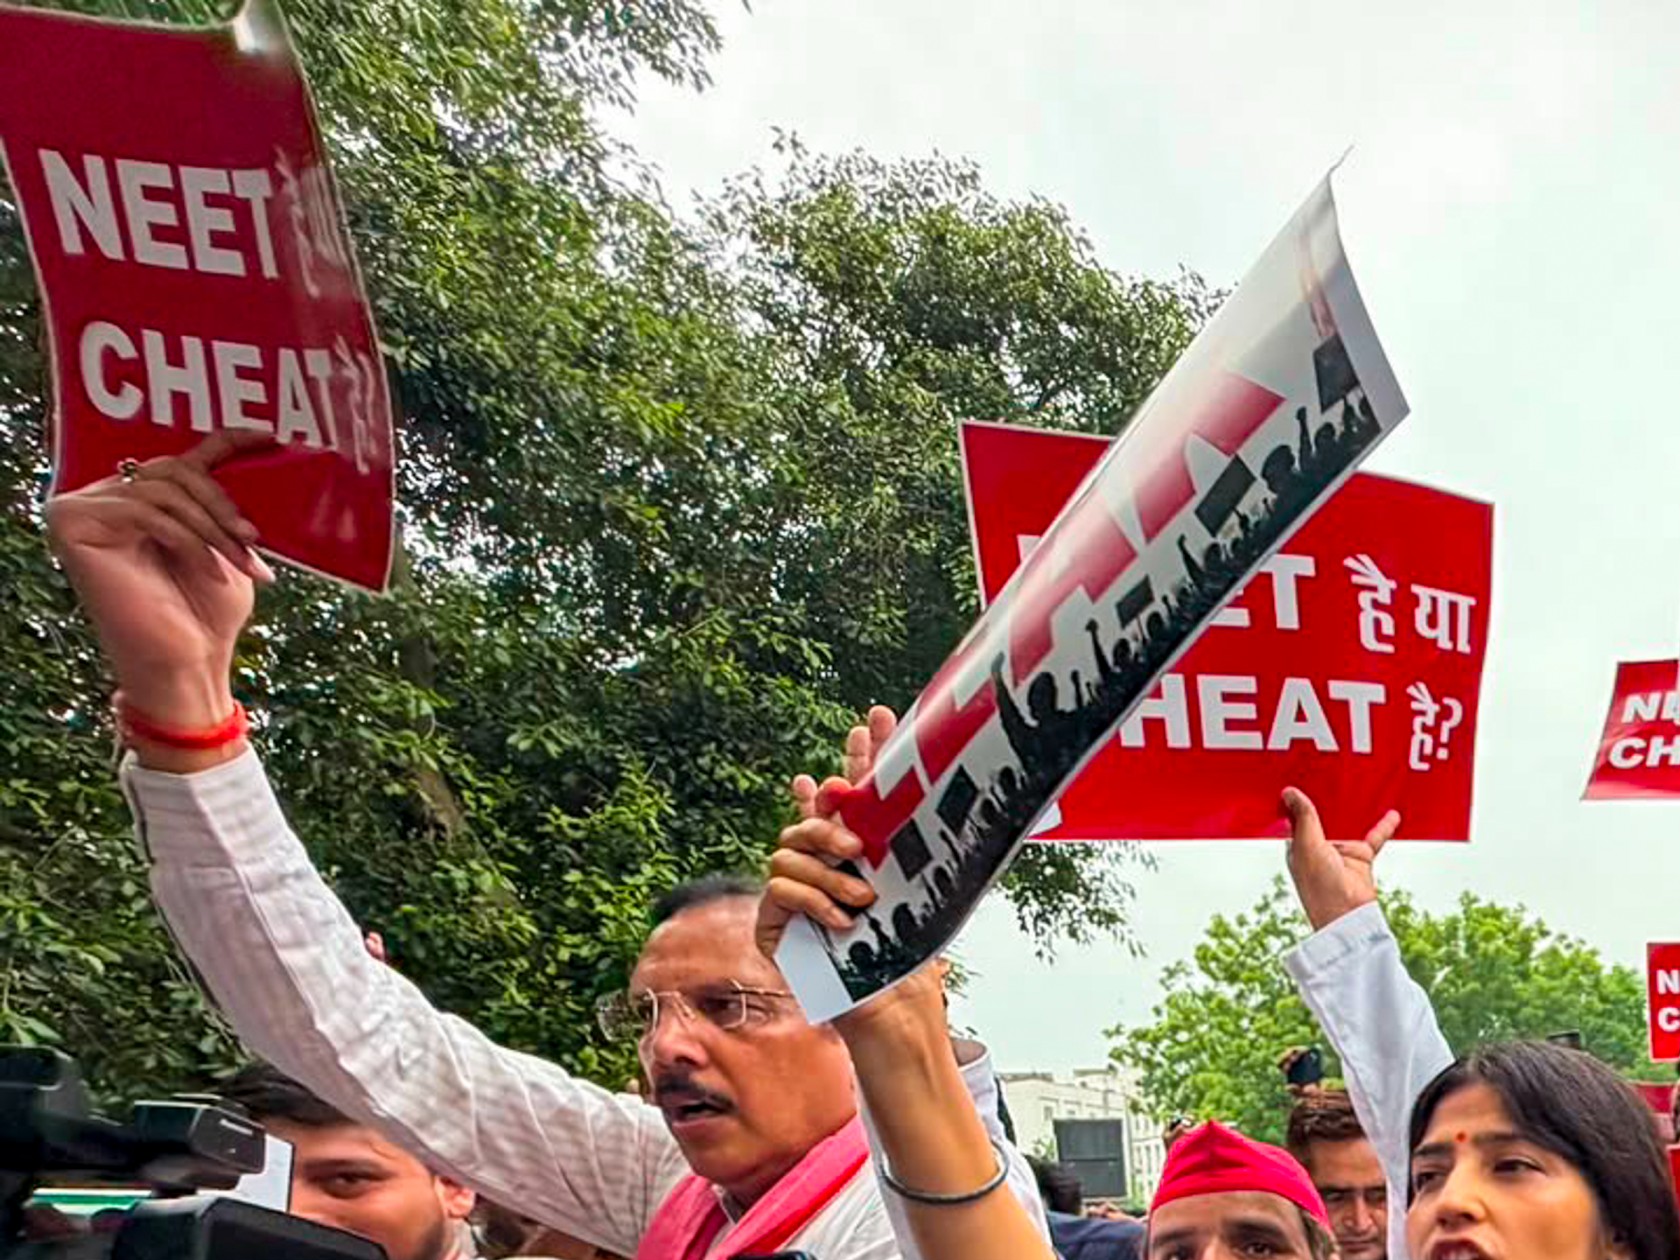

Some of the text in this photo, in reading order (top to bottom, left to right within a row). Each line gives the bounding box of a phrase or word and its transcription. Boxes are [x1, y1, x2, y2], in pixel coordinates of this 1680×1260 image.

[38, 148, 281, 281] NEET
[78, 319, 338, 453] CHEAT
[1343, 553, 1397, 654] है
[1411, 584, 1476, 655] या
[1119, 673, 1464, 772] HEAT है?
